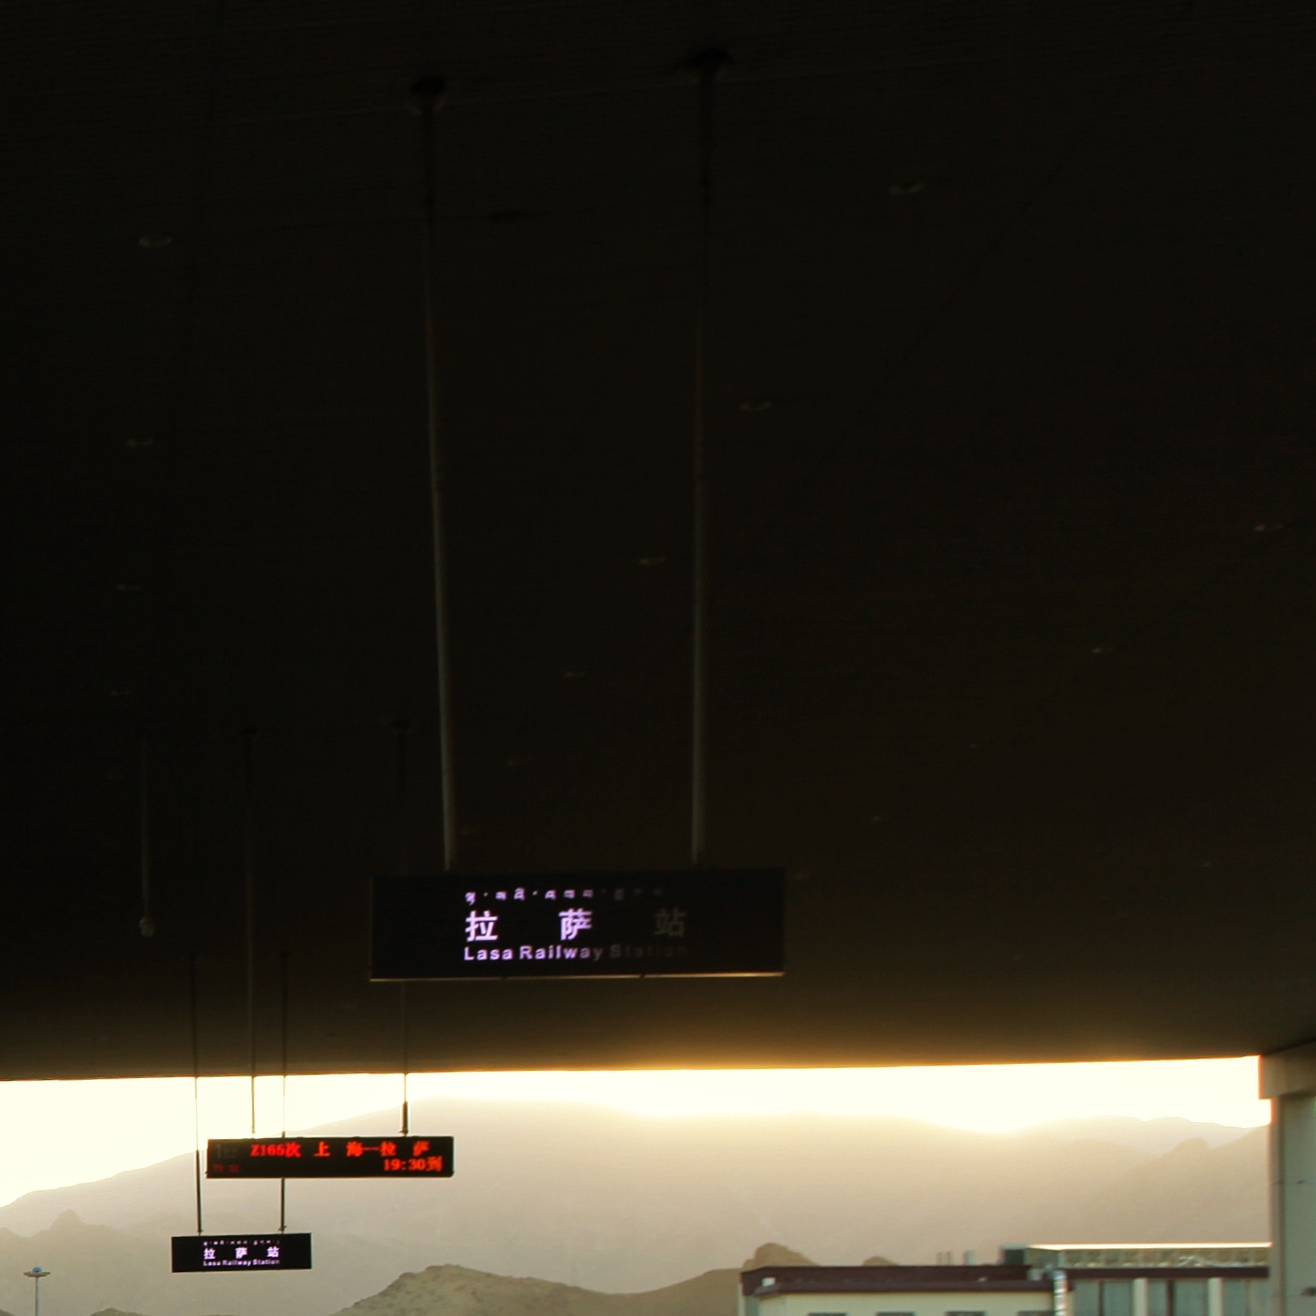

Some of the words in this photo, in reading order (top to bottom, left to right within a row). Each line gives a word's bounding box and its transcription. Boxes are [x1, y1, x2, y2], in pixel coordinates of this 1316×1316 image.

[465, 908, 687, 942] 拉萨站
[464, 946, 513, 961] Lasa
[519, 944, 604, 961] Railway
[610, 944, 688, 959] Station
[203, 1246, 280, 1260] 拉萨站
[253, 1258, 280, 1266] Station
